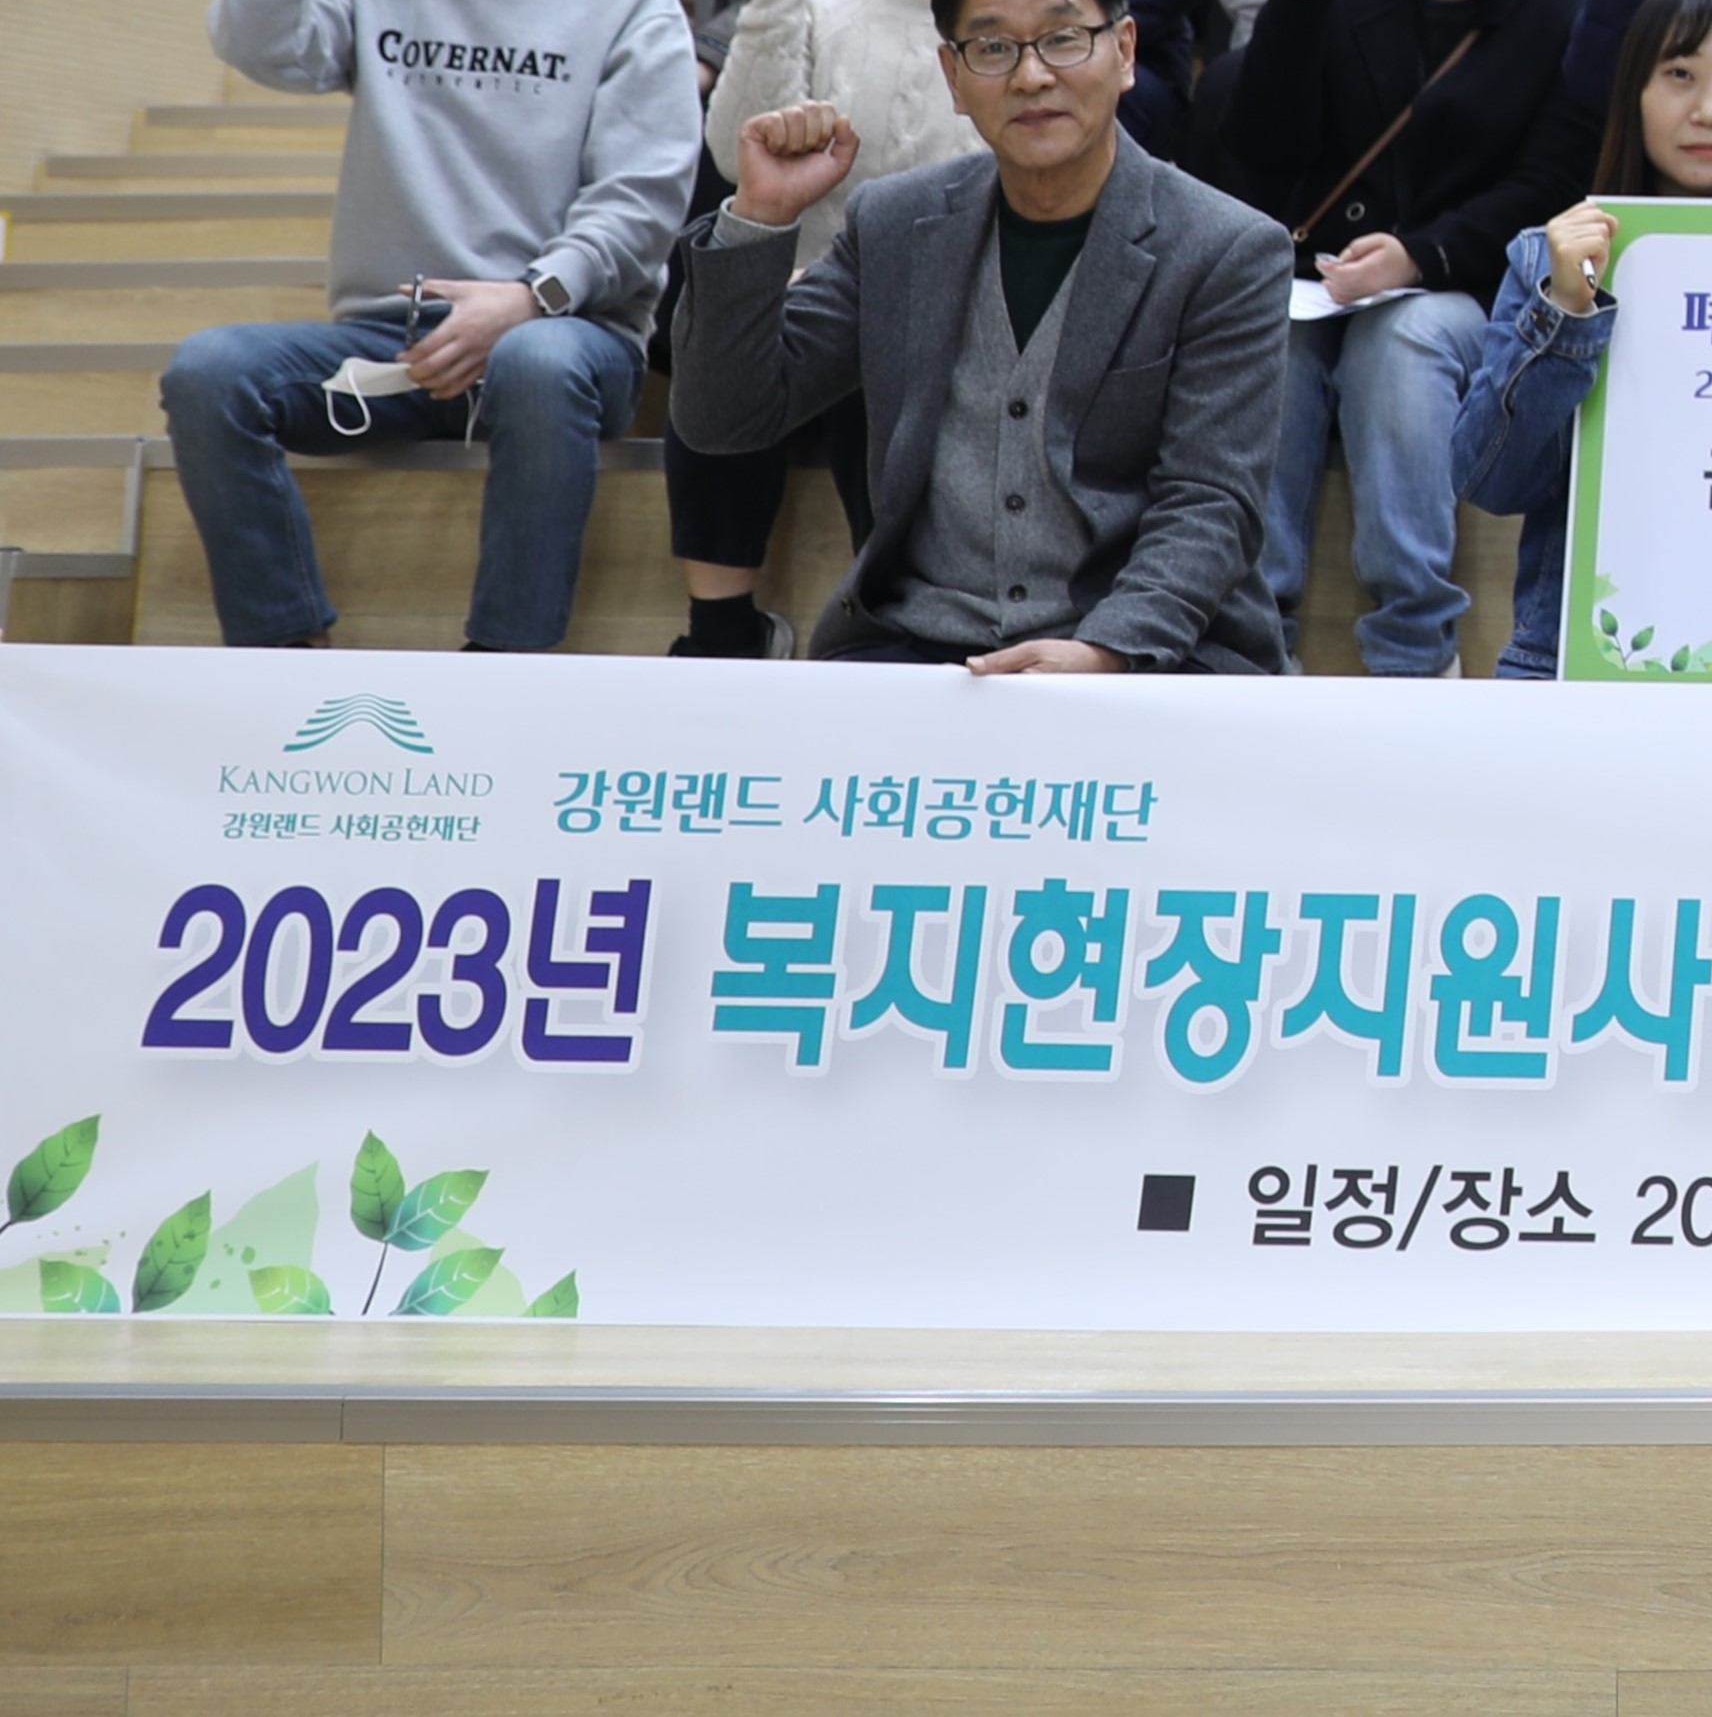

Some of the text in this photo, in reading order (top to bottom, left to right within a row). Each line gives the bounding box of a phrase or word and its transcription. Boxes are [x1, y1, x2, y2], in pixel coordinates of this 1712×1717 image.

[217, 764, 495, 798] KANGWON LAND
[552, 768, 1159, 843] 강원랜드 사회공헌재단
[222, 811, 482, 842] 강원랜드 사회공헌재단
[140, 877, 654, 1064] 2023년
[1247, 1163, 1597, 1252] 일정/장소
